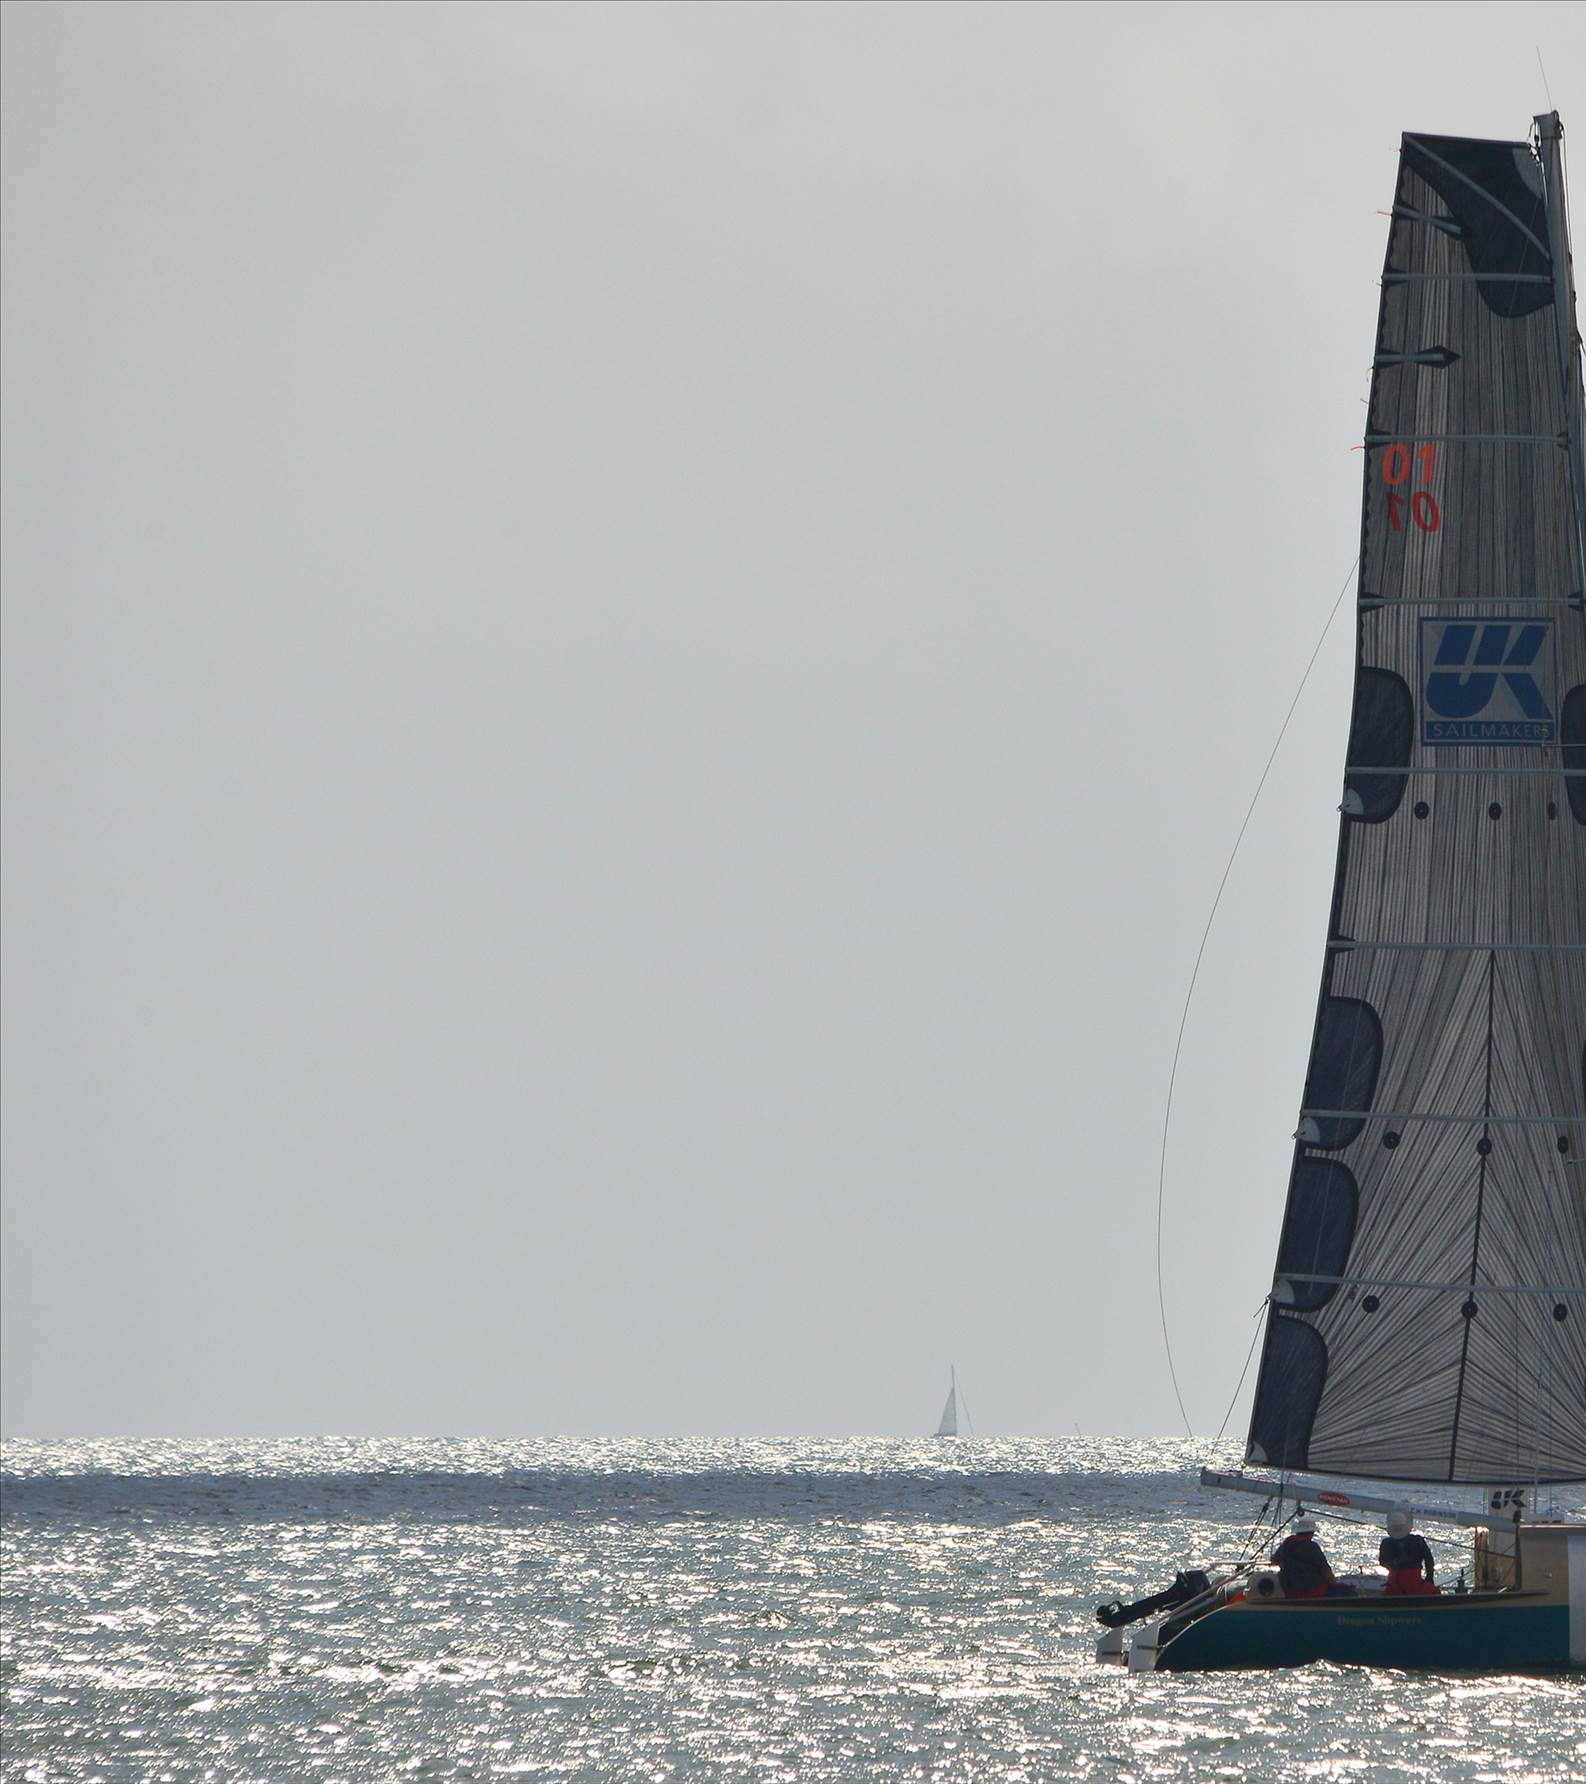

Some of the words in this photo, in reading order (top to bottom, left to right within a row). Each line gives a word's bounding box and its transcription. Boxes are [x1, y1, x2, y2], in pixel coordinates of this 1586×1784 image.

[1382, 443, 1437, 485] 01
[1426, 625, 1553, 719] UK
[1433, 722, 1550, 738] SAILMAKERS
